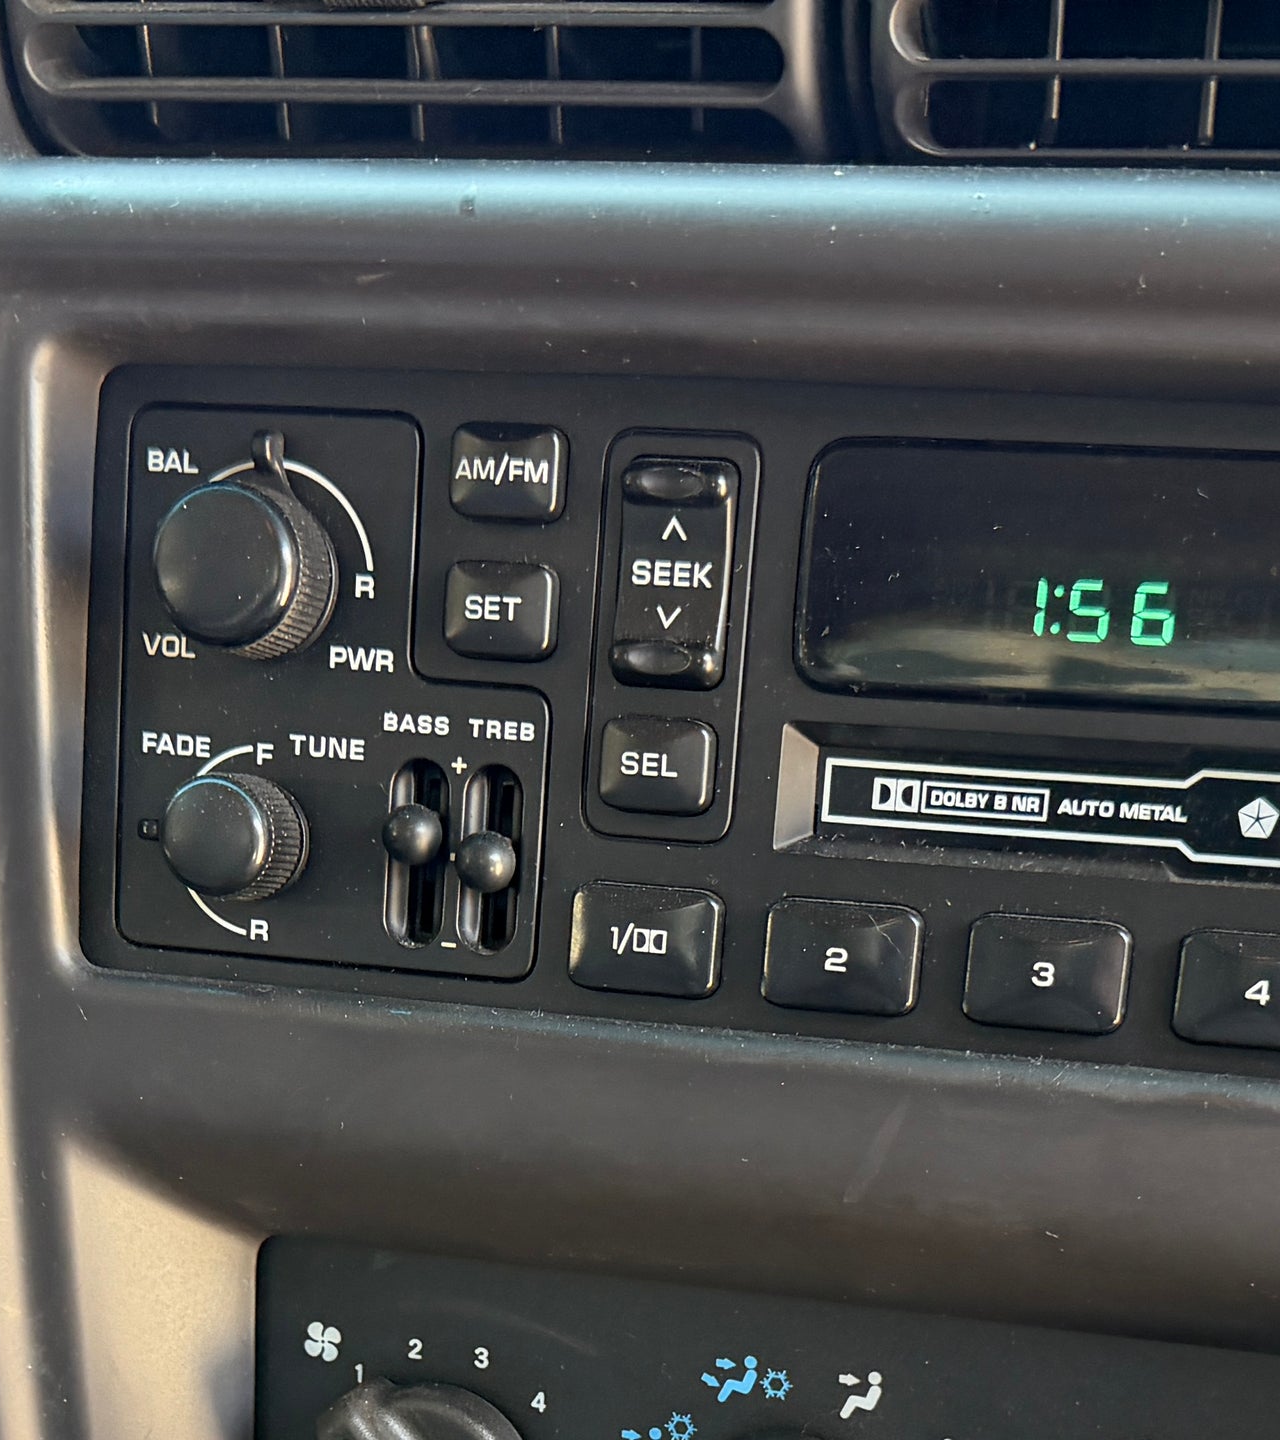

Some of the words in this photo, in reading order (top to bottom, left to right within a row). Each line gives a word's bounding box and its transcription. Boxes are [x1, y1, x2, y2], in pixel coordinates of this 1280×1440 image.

[147, 446, 199, 475] BAL
[455, 452, 549, 486] AM/FM
[354, 574, 376, 599] R
[631, 559, 714, 590] SEEK
[464, 594, 522, 622] SET
[1033, 577, 1176, 647] 1:56
[141, 632, 196, 660] VOL
[329, 645, 394, 673] PWR
[383, 712, 450, 736] BASS
[468, 717, 536, 742] TREB
[141, 730, 212, 759] FADE
[256, 742, 274, 766] F
[289, 733, 366, 762] TUNE
[620, 751, 678, 779] SEL
[930, 789, 989, 810] DOLBY
[993, 794, 1007, 811] B
[1011, 795, 1040, 813] NR
[1057, 799, 1114, 818] AUTO
[1119, 802, 1188, 824] METAL
[250, 919, 269, 942] R
[824, 947, 848, 973] 2
[1031, 961, 1055, 987] 3
[1244, 979, 1271, 1007] 4
[407, 1338, 423, 1360] 2
[474, 1347, 490, 1369] 3
[354, 1363, 364, 1384] 1
[530, 1391, 547, 1413] 4
